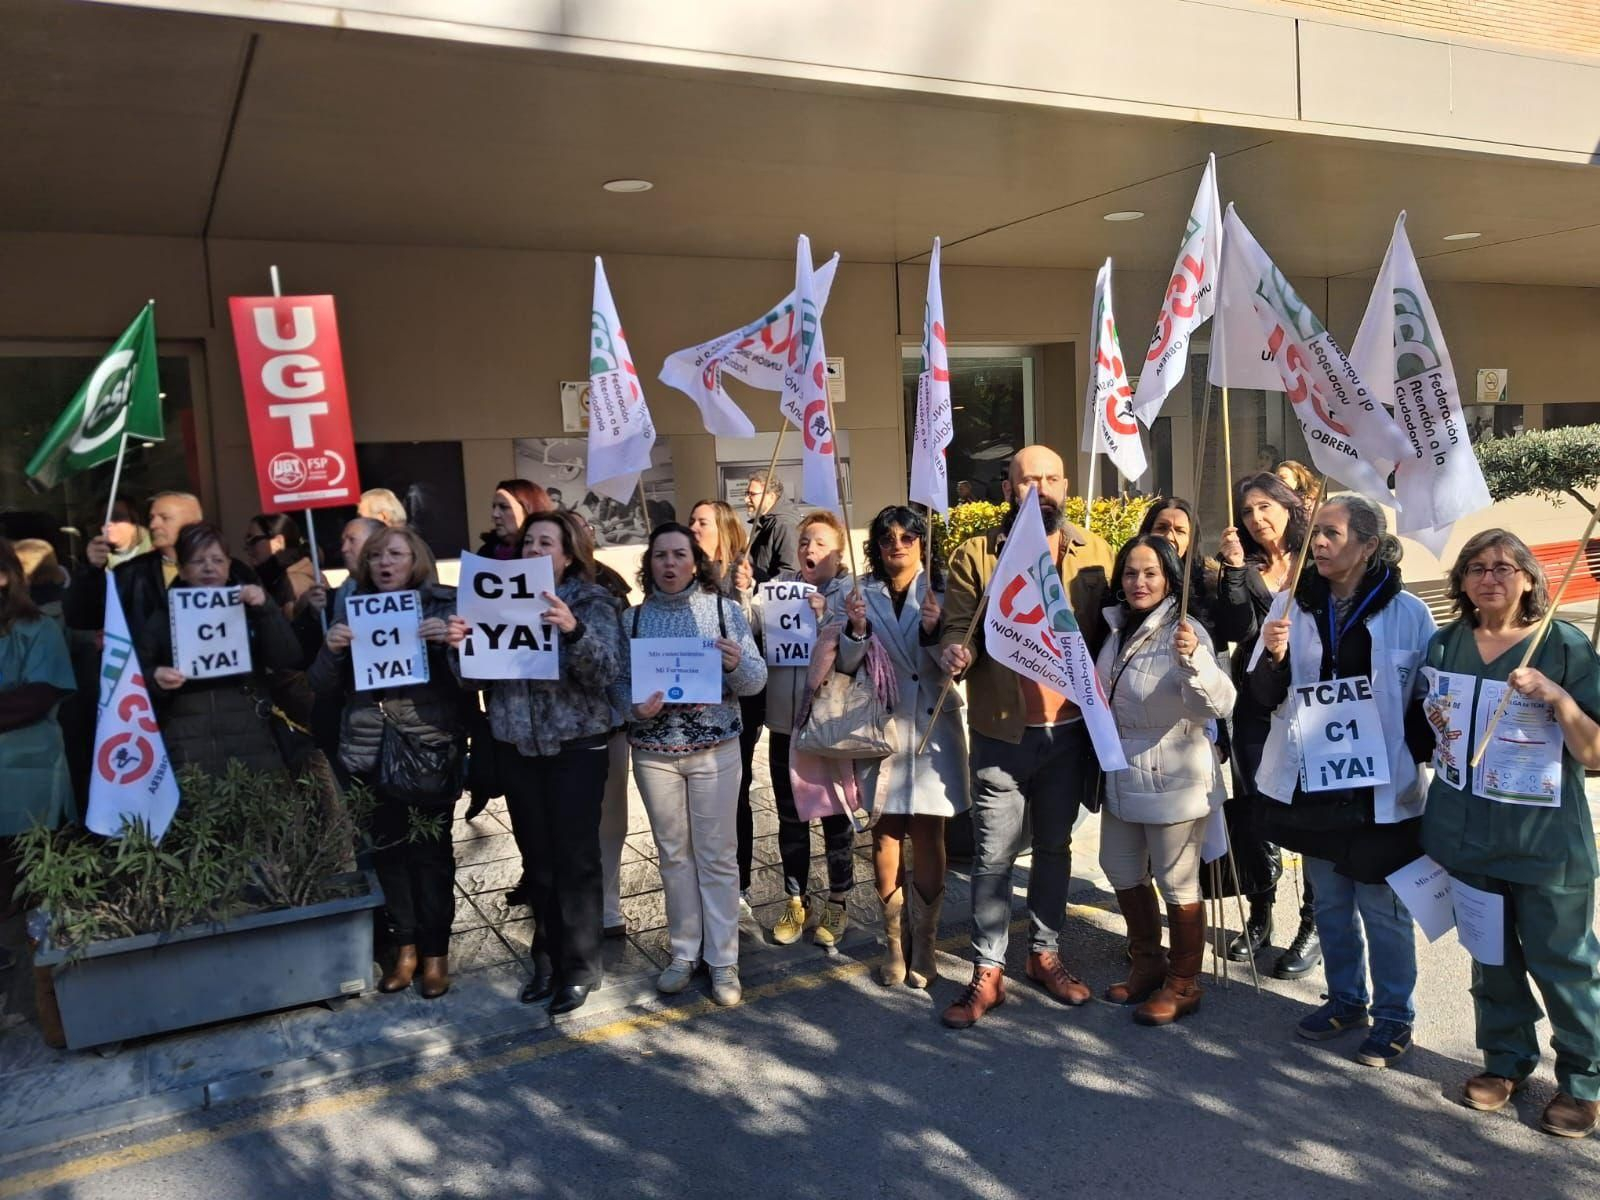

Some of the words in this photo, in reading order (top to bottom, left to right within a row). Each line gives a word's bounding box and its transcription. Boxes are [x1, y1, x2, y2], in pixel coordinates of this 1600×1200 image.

[252, 306, 329, 449] UGT
[597, 375, 614, 417] Atención
[612, 426, 621, 437] la
[611, 372, 629, 424] Federación
[1409, 380, 1437, 438] Atención
[1428, 372, 1459, 446] Federación
[1395, 386, 1424, 459] Ciudadanía
[1311, 429, 1359, 460] OBRERA
[1429, 440, 1440, 450] a
[307, 457, 328, 470] FSP
[1433, 451, 1447, 466] la
[473, 571, 535, 599] C1
[765, 586, 816, 601] TCAE
[177, 590, 240, 609] TCAE
[350, 594, 415, 617] TCAE
[198, 623, 226, 640] C1
[780, 614, 801, 629] C1
[371, 628, 400, 647] C1
[464, 623, 553, 656] ¡YA!
[193, 651, 238, 676] ¡YA!
[775, 643, 809, 663] ¡YA!
[367, 659, 412, 685] ¡YA!
[1008, 650, 1068, 688] Andalucía
[1297, 680, 1372, 707] TCAE
[1325, 720, 1359, 742] C1
[1321, 757, 1375, 787] ¡YA!
